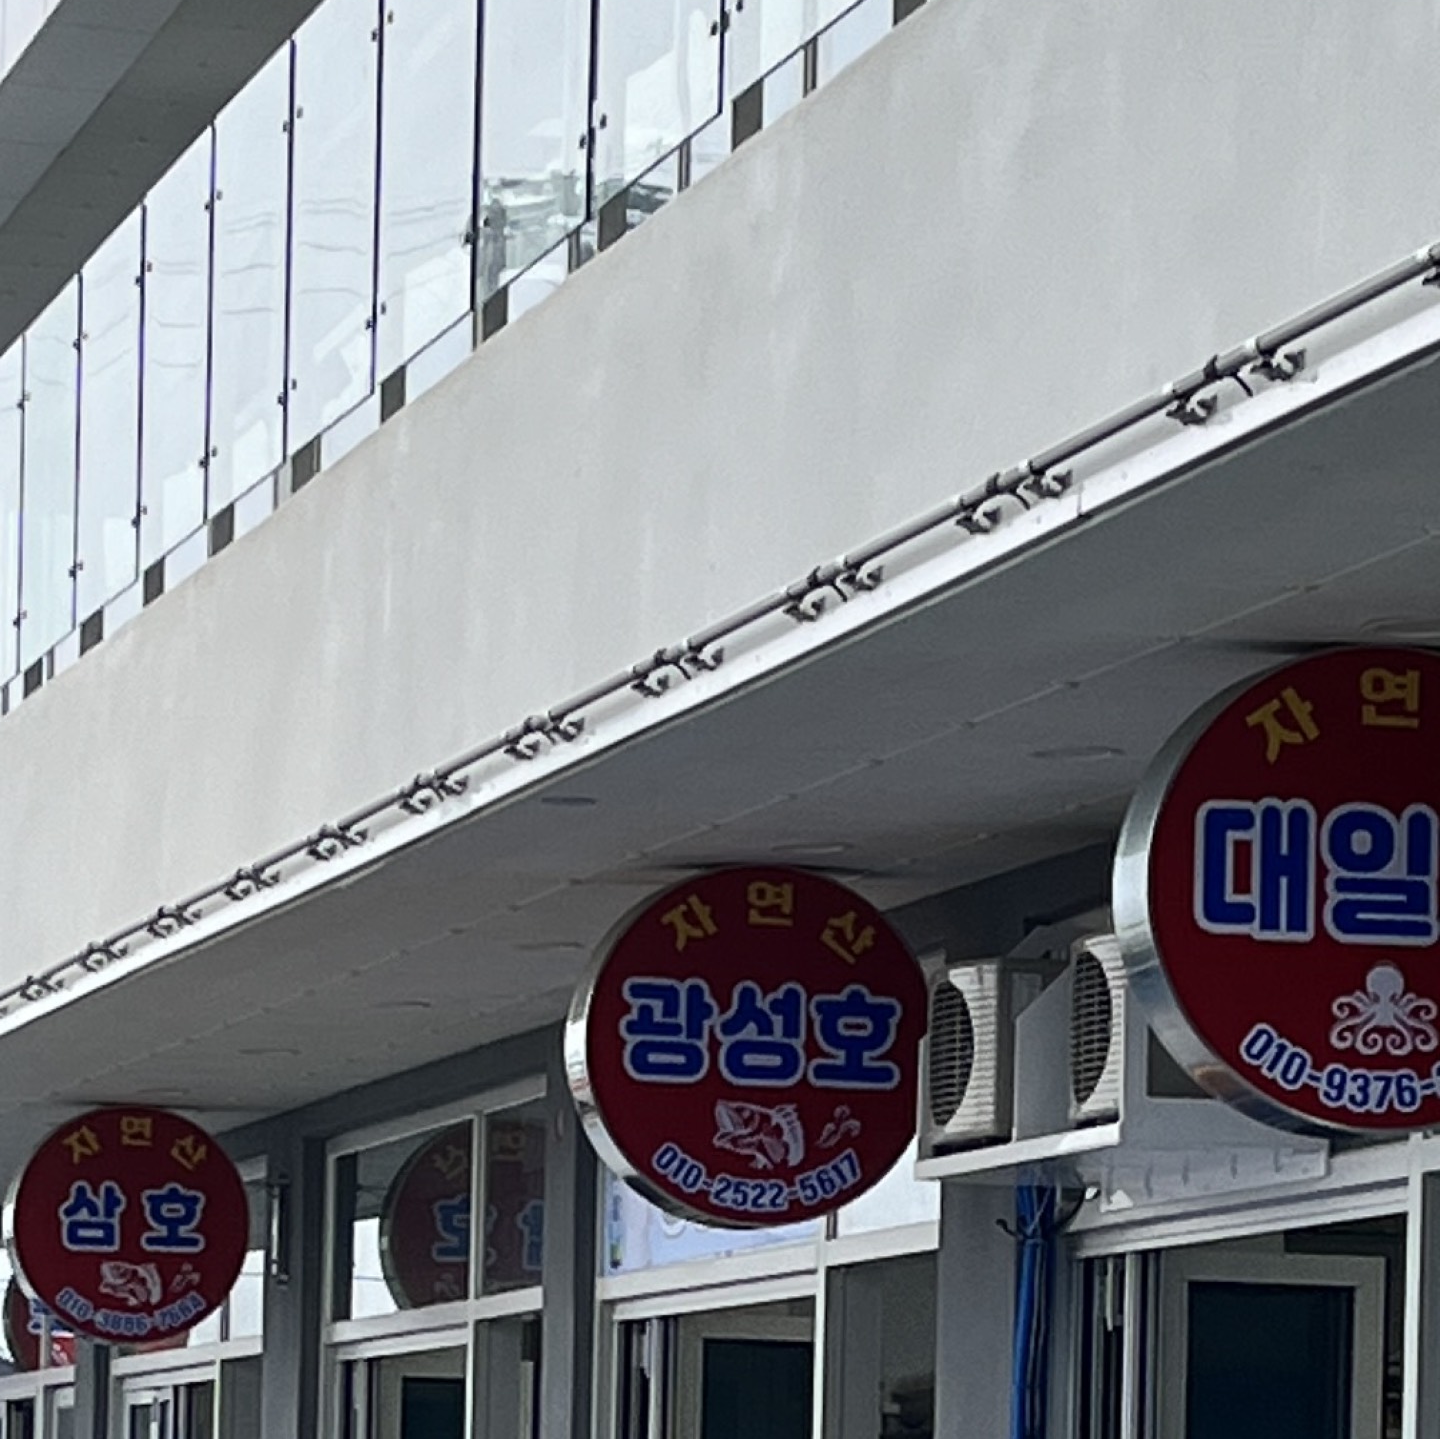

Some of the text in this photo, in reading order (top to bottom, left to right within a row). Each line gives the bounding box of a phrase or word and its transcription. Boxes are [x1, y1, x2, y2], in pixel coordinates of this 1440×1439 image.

[619, 977, 902, 1091] 광성호
[652, 1142, 862, 1213] 010-2522-5617
[58, 1179, 206, 1254] 삼호
